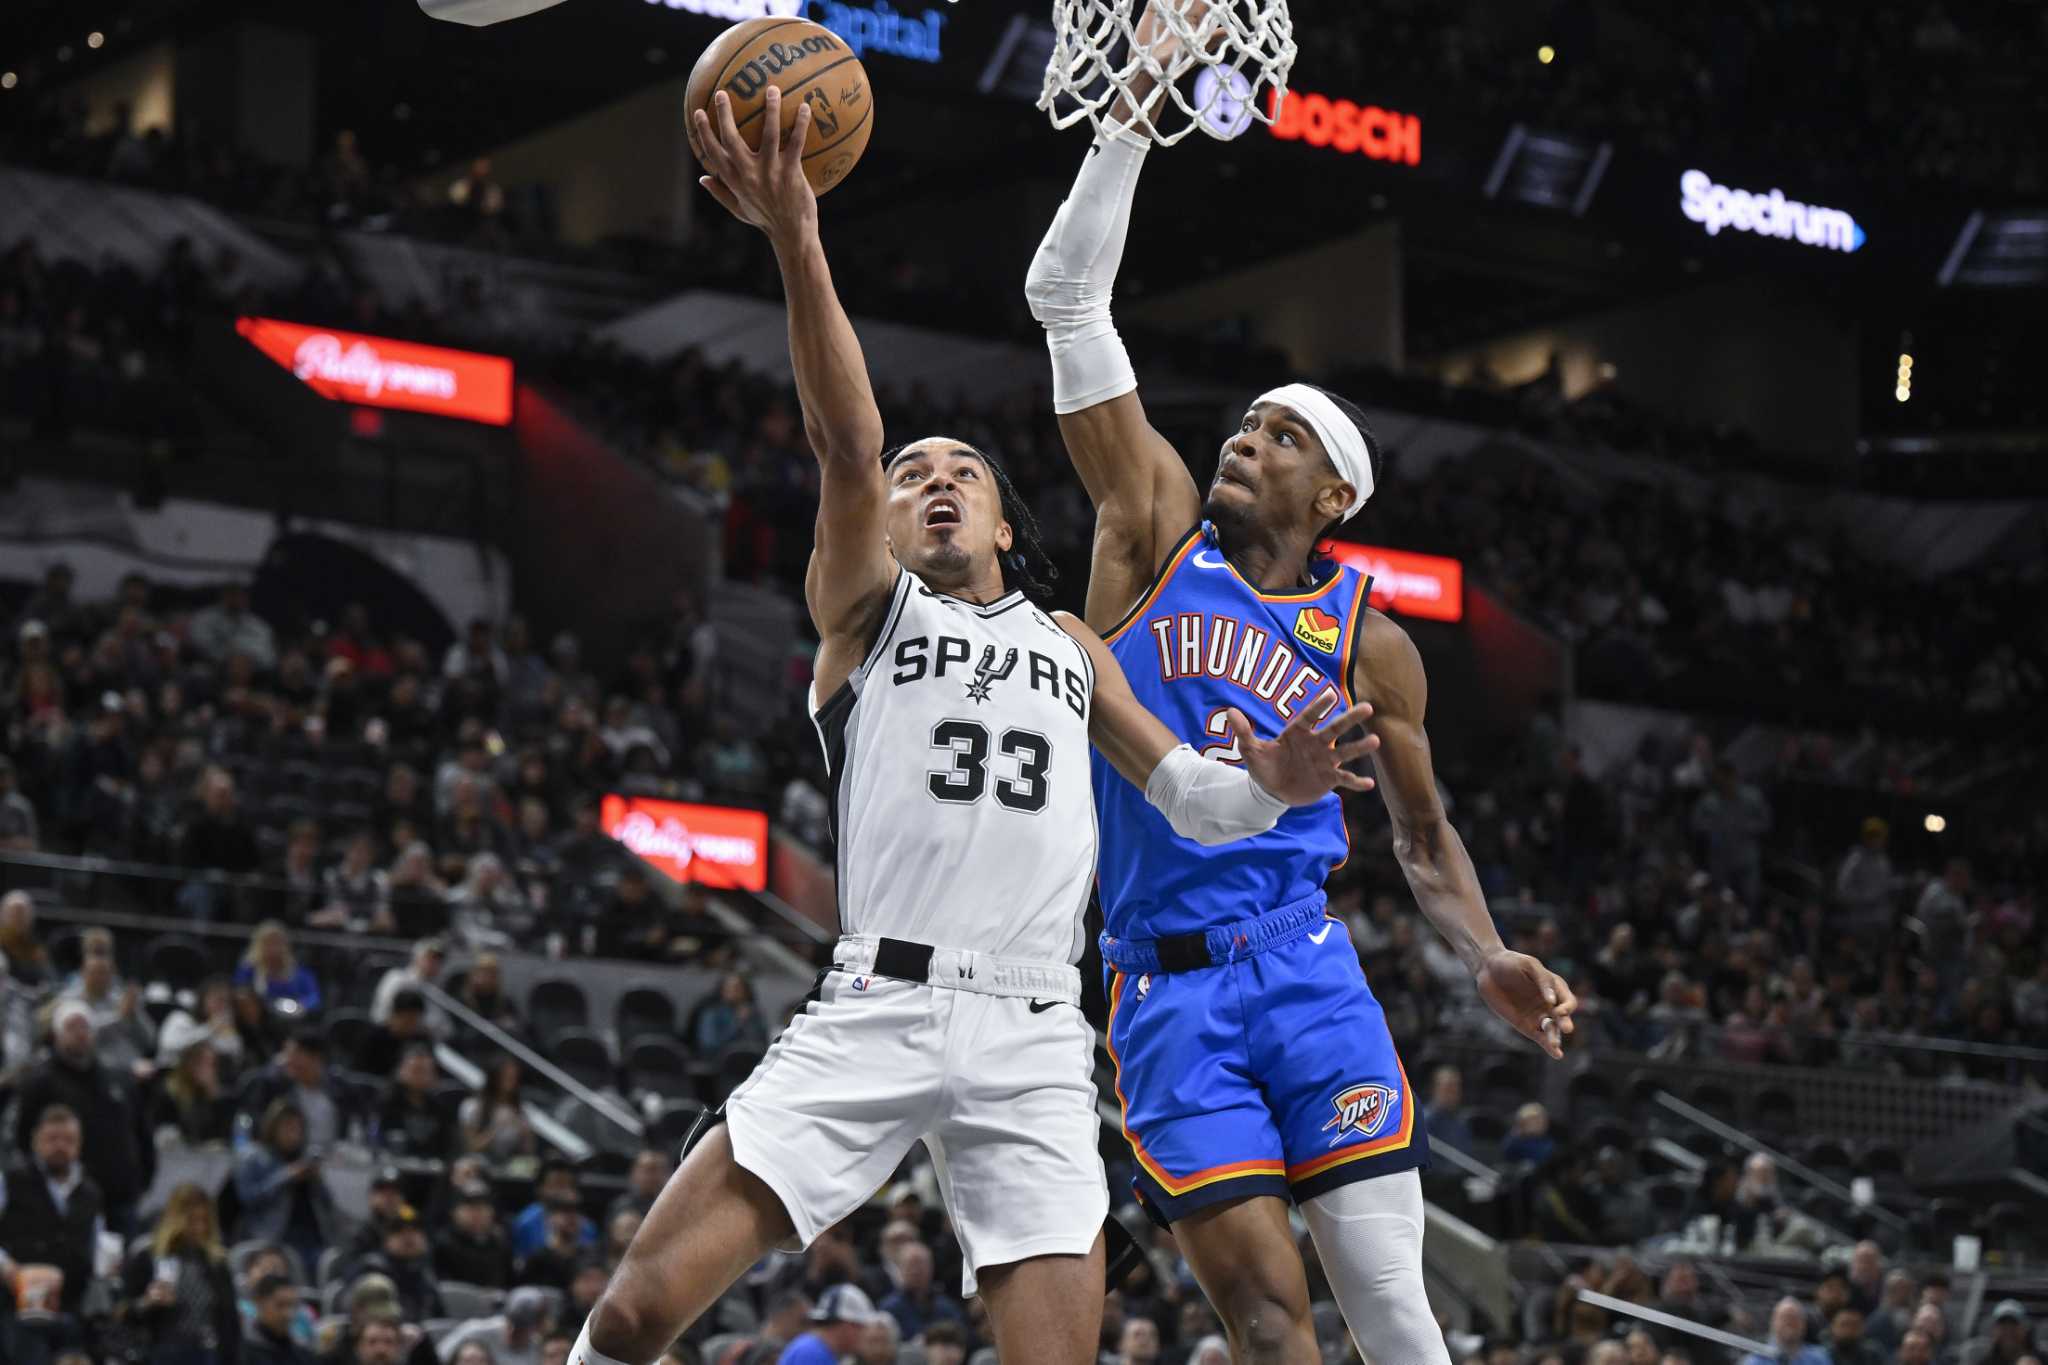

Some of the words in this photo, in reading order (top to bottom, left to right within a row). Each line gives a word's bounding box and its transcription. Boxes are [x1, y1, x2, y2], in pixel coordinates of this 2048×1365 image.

[727, 34, 841, 101] Wilson
[1268, 87, 1422, 167] BOSCH
[1680, 169, 1855, 253] Spectrum
[893, 636, 1086, 720] SPURS
[926, 717, 1053, 815] 33
[1340, 1093, 1379, 1132] OKC
